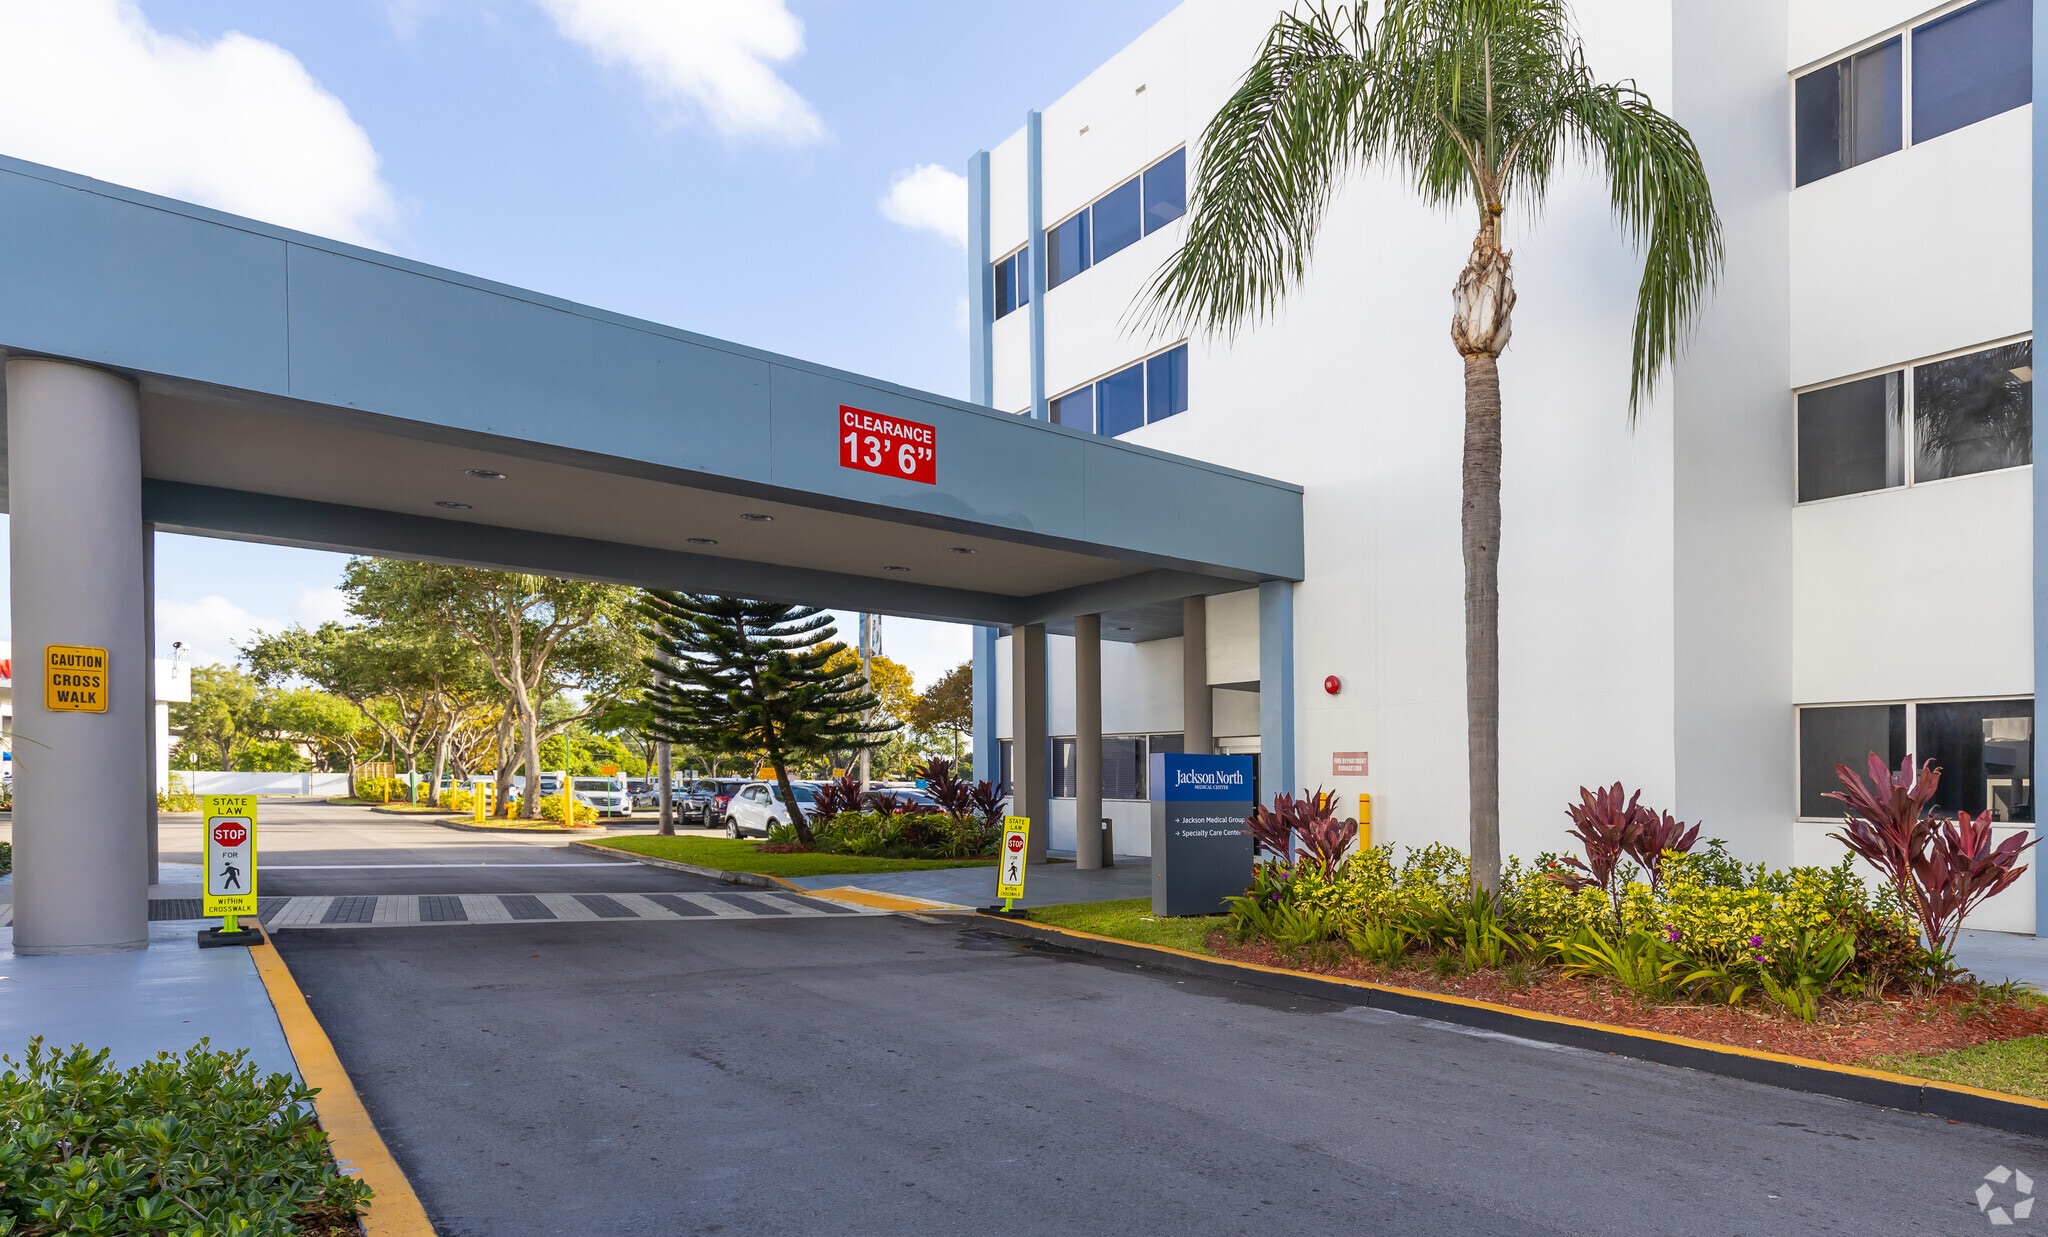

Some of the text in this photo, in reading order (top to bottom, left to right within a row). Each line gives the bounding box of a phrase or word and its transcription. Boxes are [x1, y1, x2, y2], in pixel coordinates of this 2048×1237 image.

[844, 411, 932, 444] CLEARANCE
[51, 653, 102, 668] CAUTION
[53, 673, 100, 688] CROSS
[57, 690, 96, 704] WALK
[1175, 769, 1244, 787] Jackson North
[213, 798, 248, 806] STATE
[218, 807, 243, 815] LAW
[1182, 816, 1205, 824] Jackson
[1228, 816, 1245, 825] Group
[215, 829, 246, 840] STOP
[1182, 829, 1208, 838] Specialty
[1008, 840, 1024, 848] STOP
